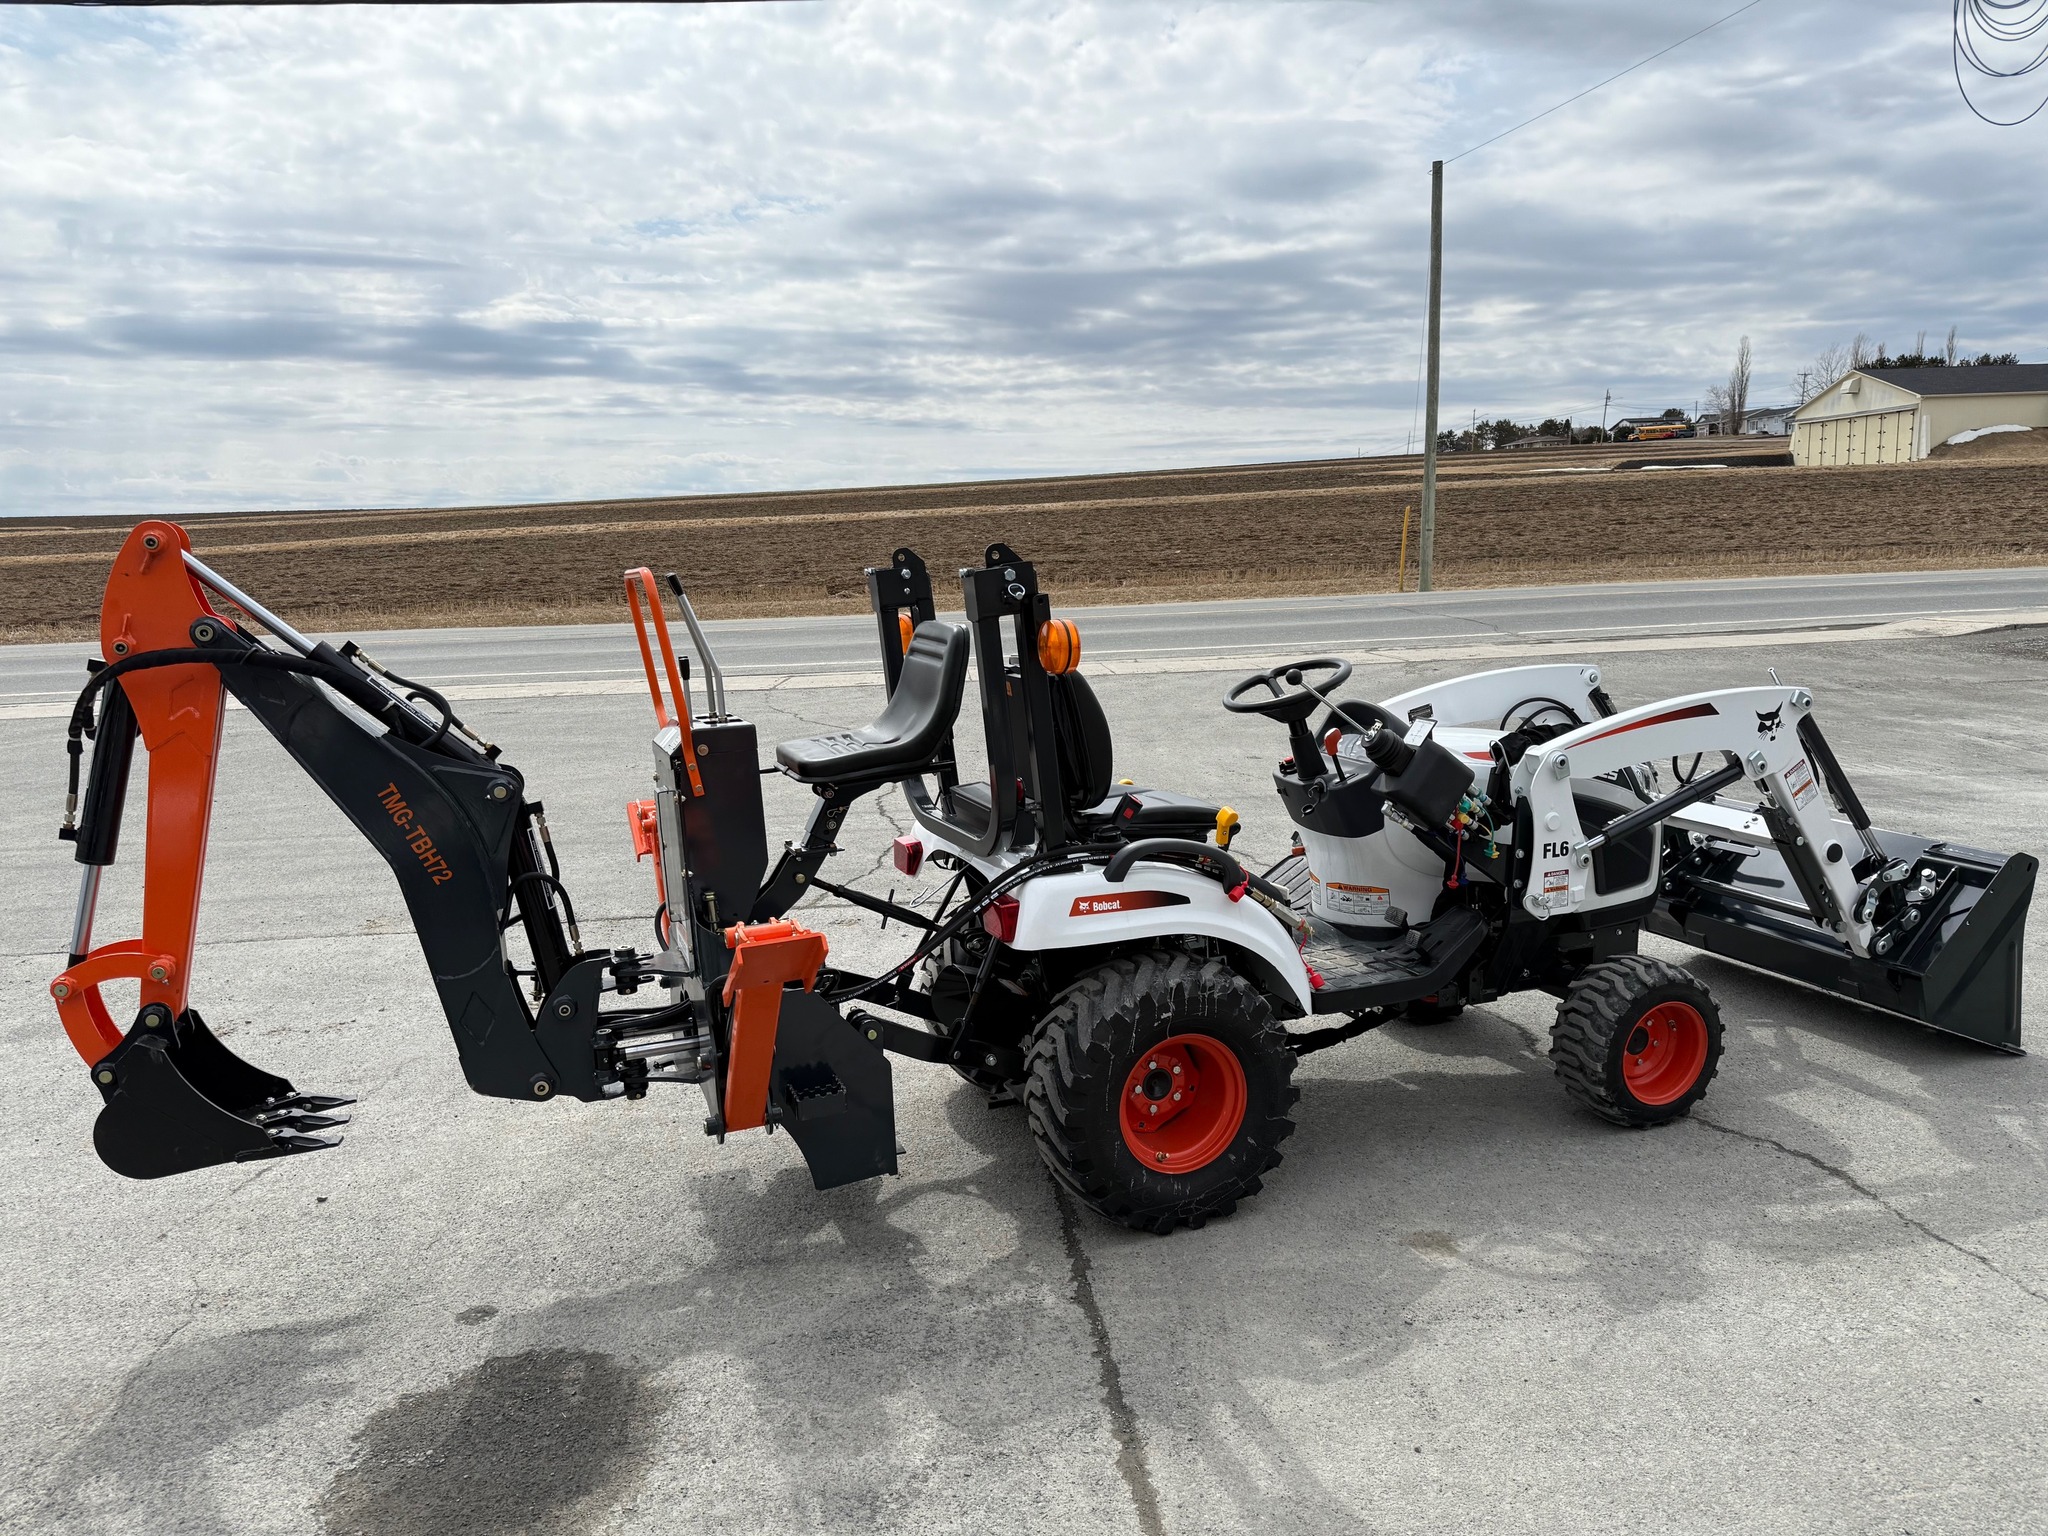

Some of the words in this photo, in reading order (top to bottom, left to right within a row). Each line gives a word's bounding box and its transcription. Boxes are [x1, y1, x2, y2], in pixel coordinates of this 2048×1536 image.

[377, 782, 453, 886] TMG-TBH72
[1543, 841, 1569, 859] FL6
[1344, 884, 1373, 893] WARNING
[1093, 900, 1121, 911] Bobcat
